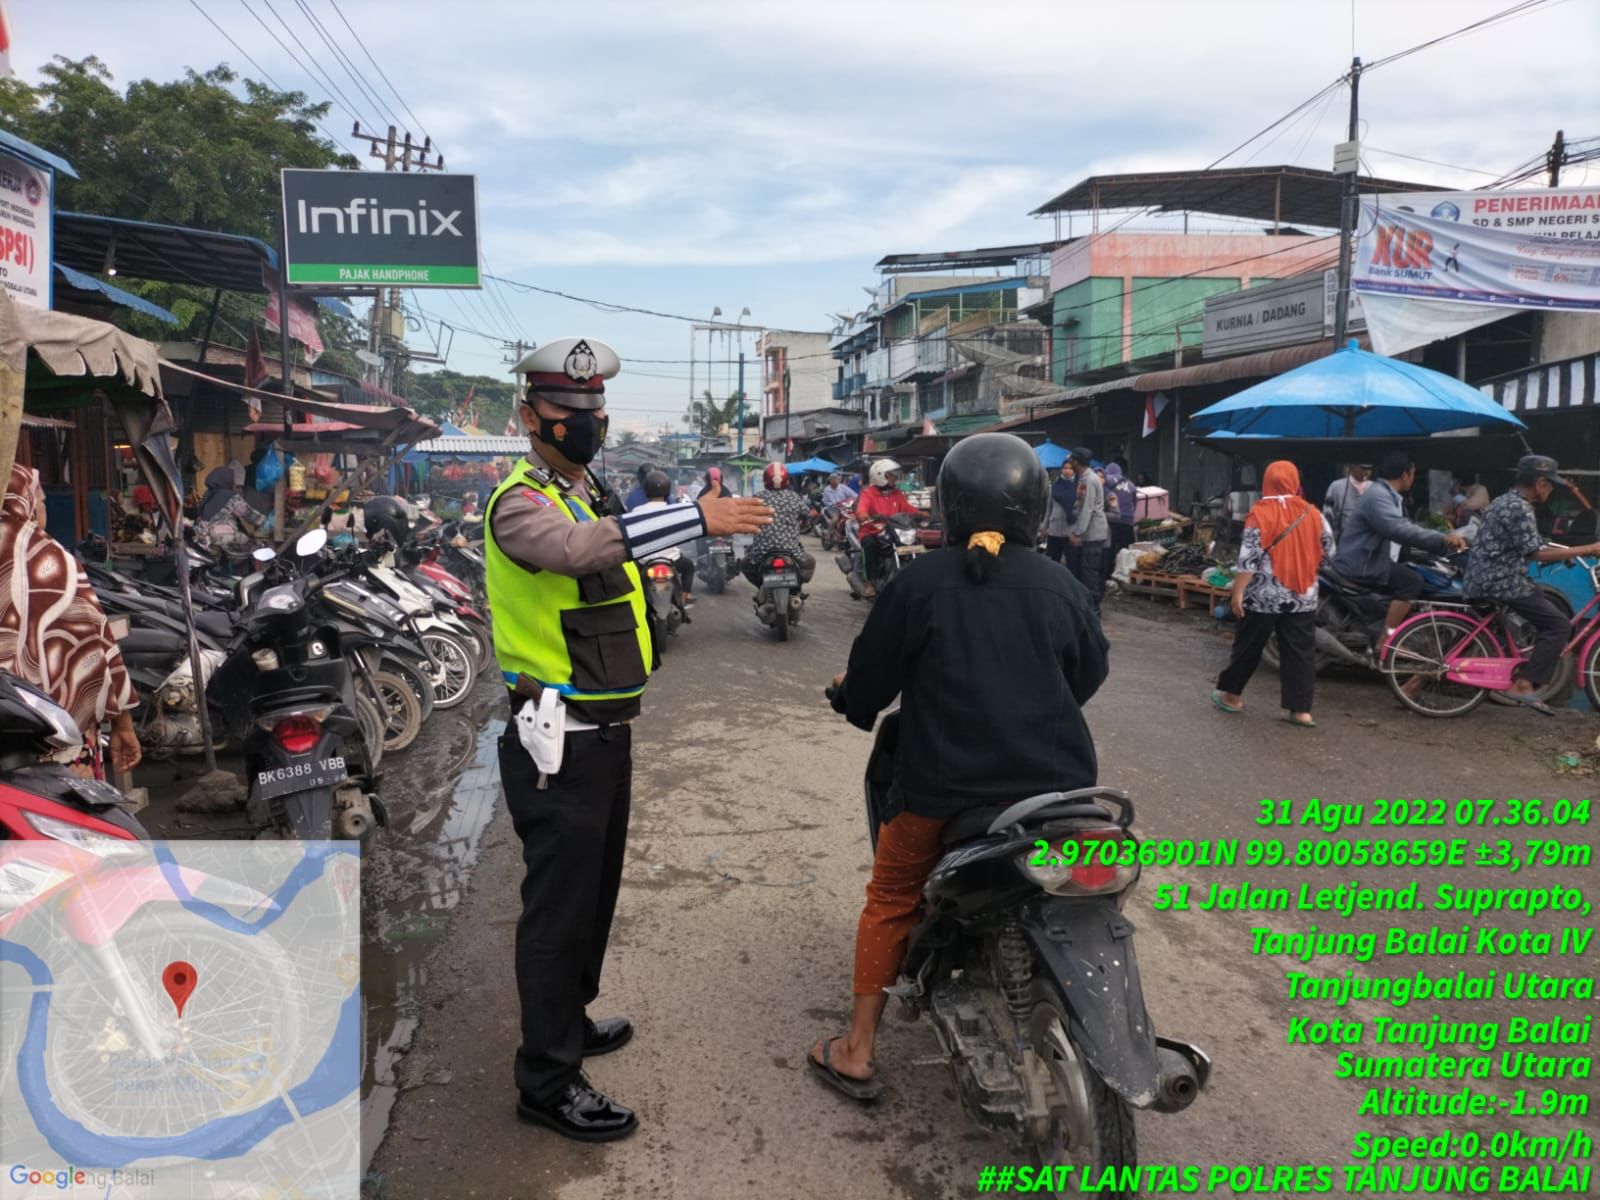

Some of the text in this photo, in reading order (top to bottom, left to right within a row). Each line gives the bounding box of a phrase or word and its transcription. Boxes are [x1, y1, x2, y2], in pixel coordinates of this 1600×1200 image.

[297, 197, 463, 237] Infinix
[1493, 217, 1502, 227] &
[1506, 216, 1535, 227] SMP
[1538, 215, 1588, 226] NEGERI
[1371, 223, 1434, 269] KUR
[339, 267, 430, 281] PAJAK HANDPHONE
[1368, 266, 1433, 280] Bank SUMUT
[1216, 314, 1254, 332] KURNIA
[1262, 301, 1306, 323] DADANG
[318, 757, 345, 771] VBB
